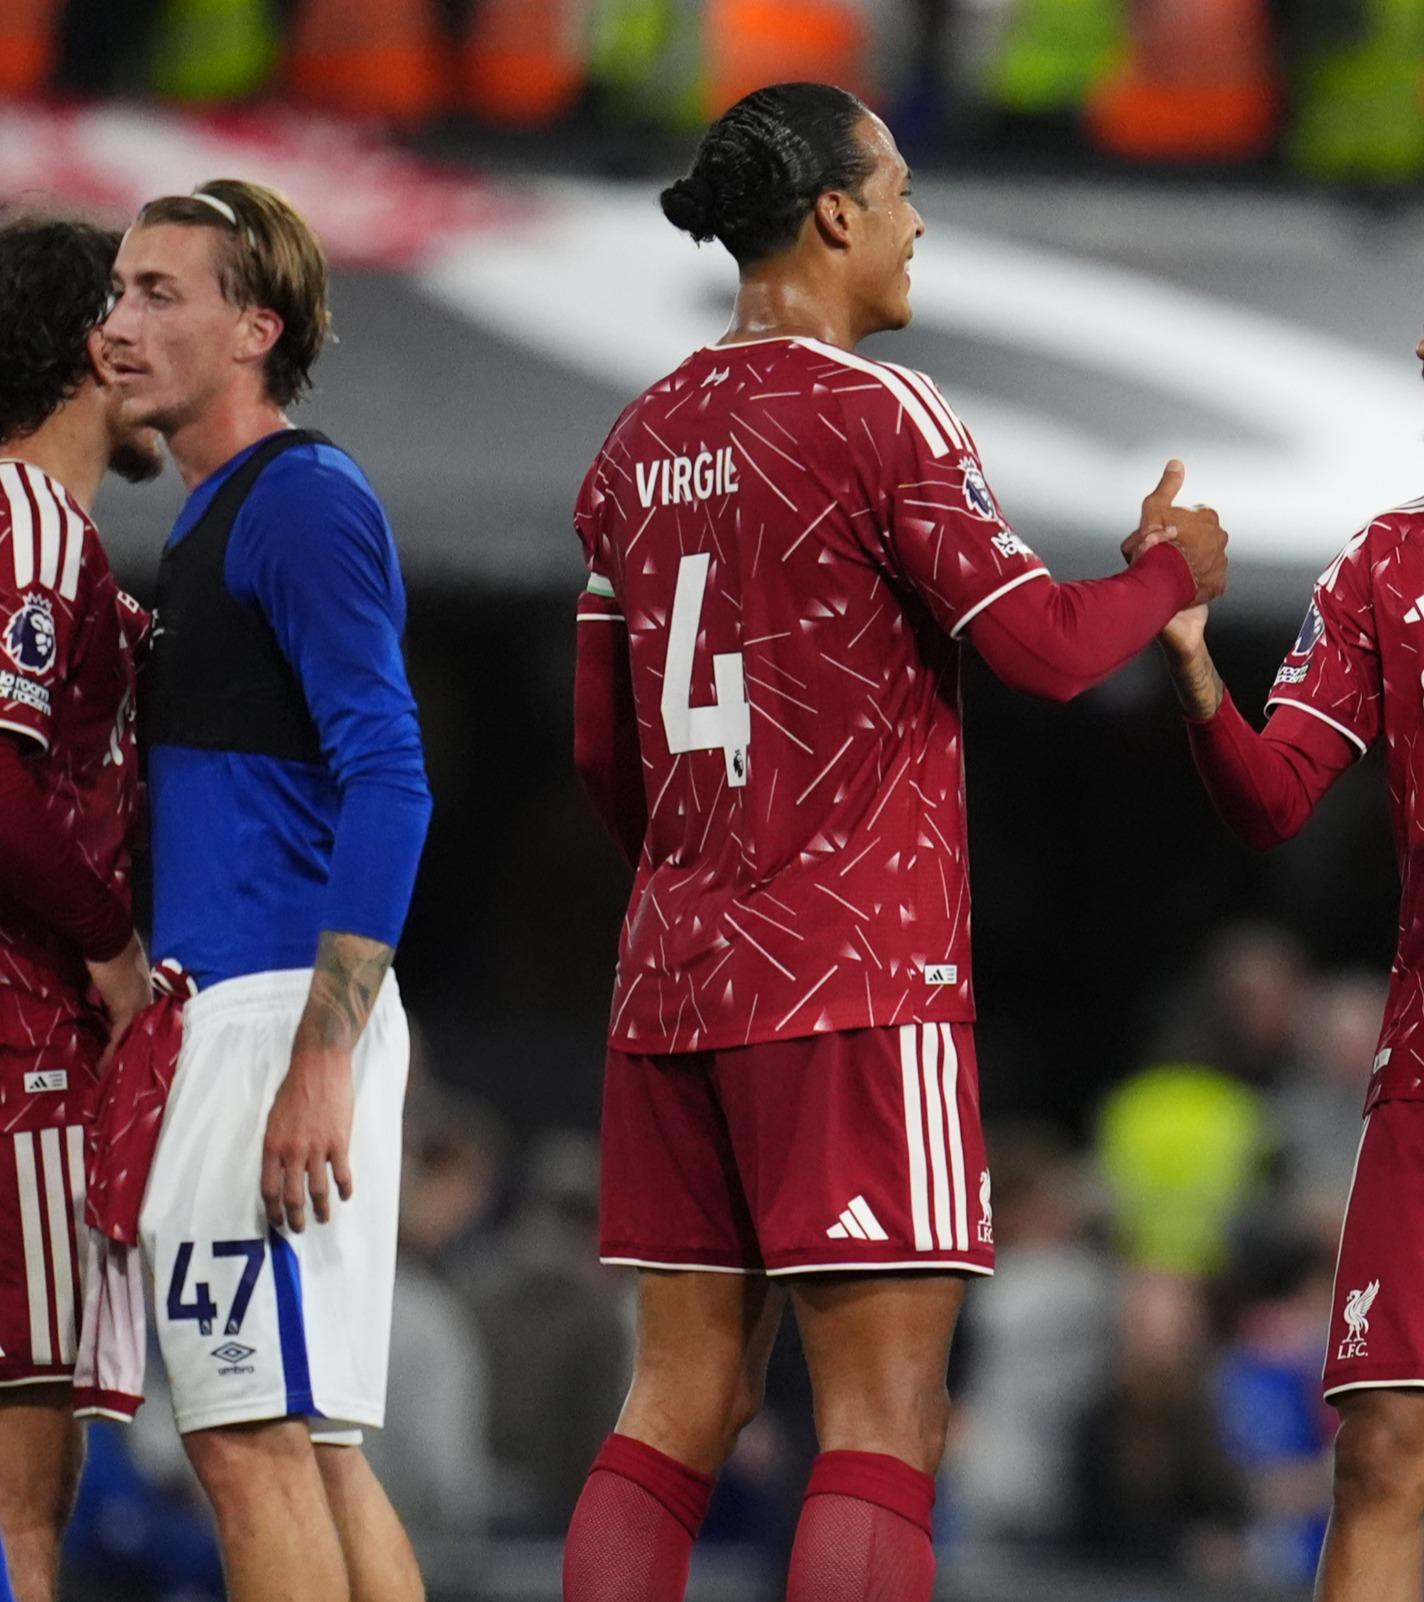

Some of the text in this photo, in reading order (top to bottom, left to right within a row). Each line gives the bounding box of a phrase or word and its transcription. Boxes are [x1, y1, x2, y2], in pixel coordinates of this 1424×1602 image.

[636, 447, 739, 508] VIRGIL
[661, 552, 750, 788] 4
[167, 1238, 266, 1336] 47
[218, 1365, 255, 1376] umbro
